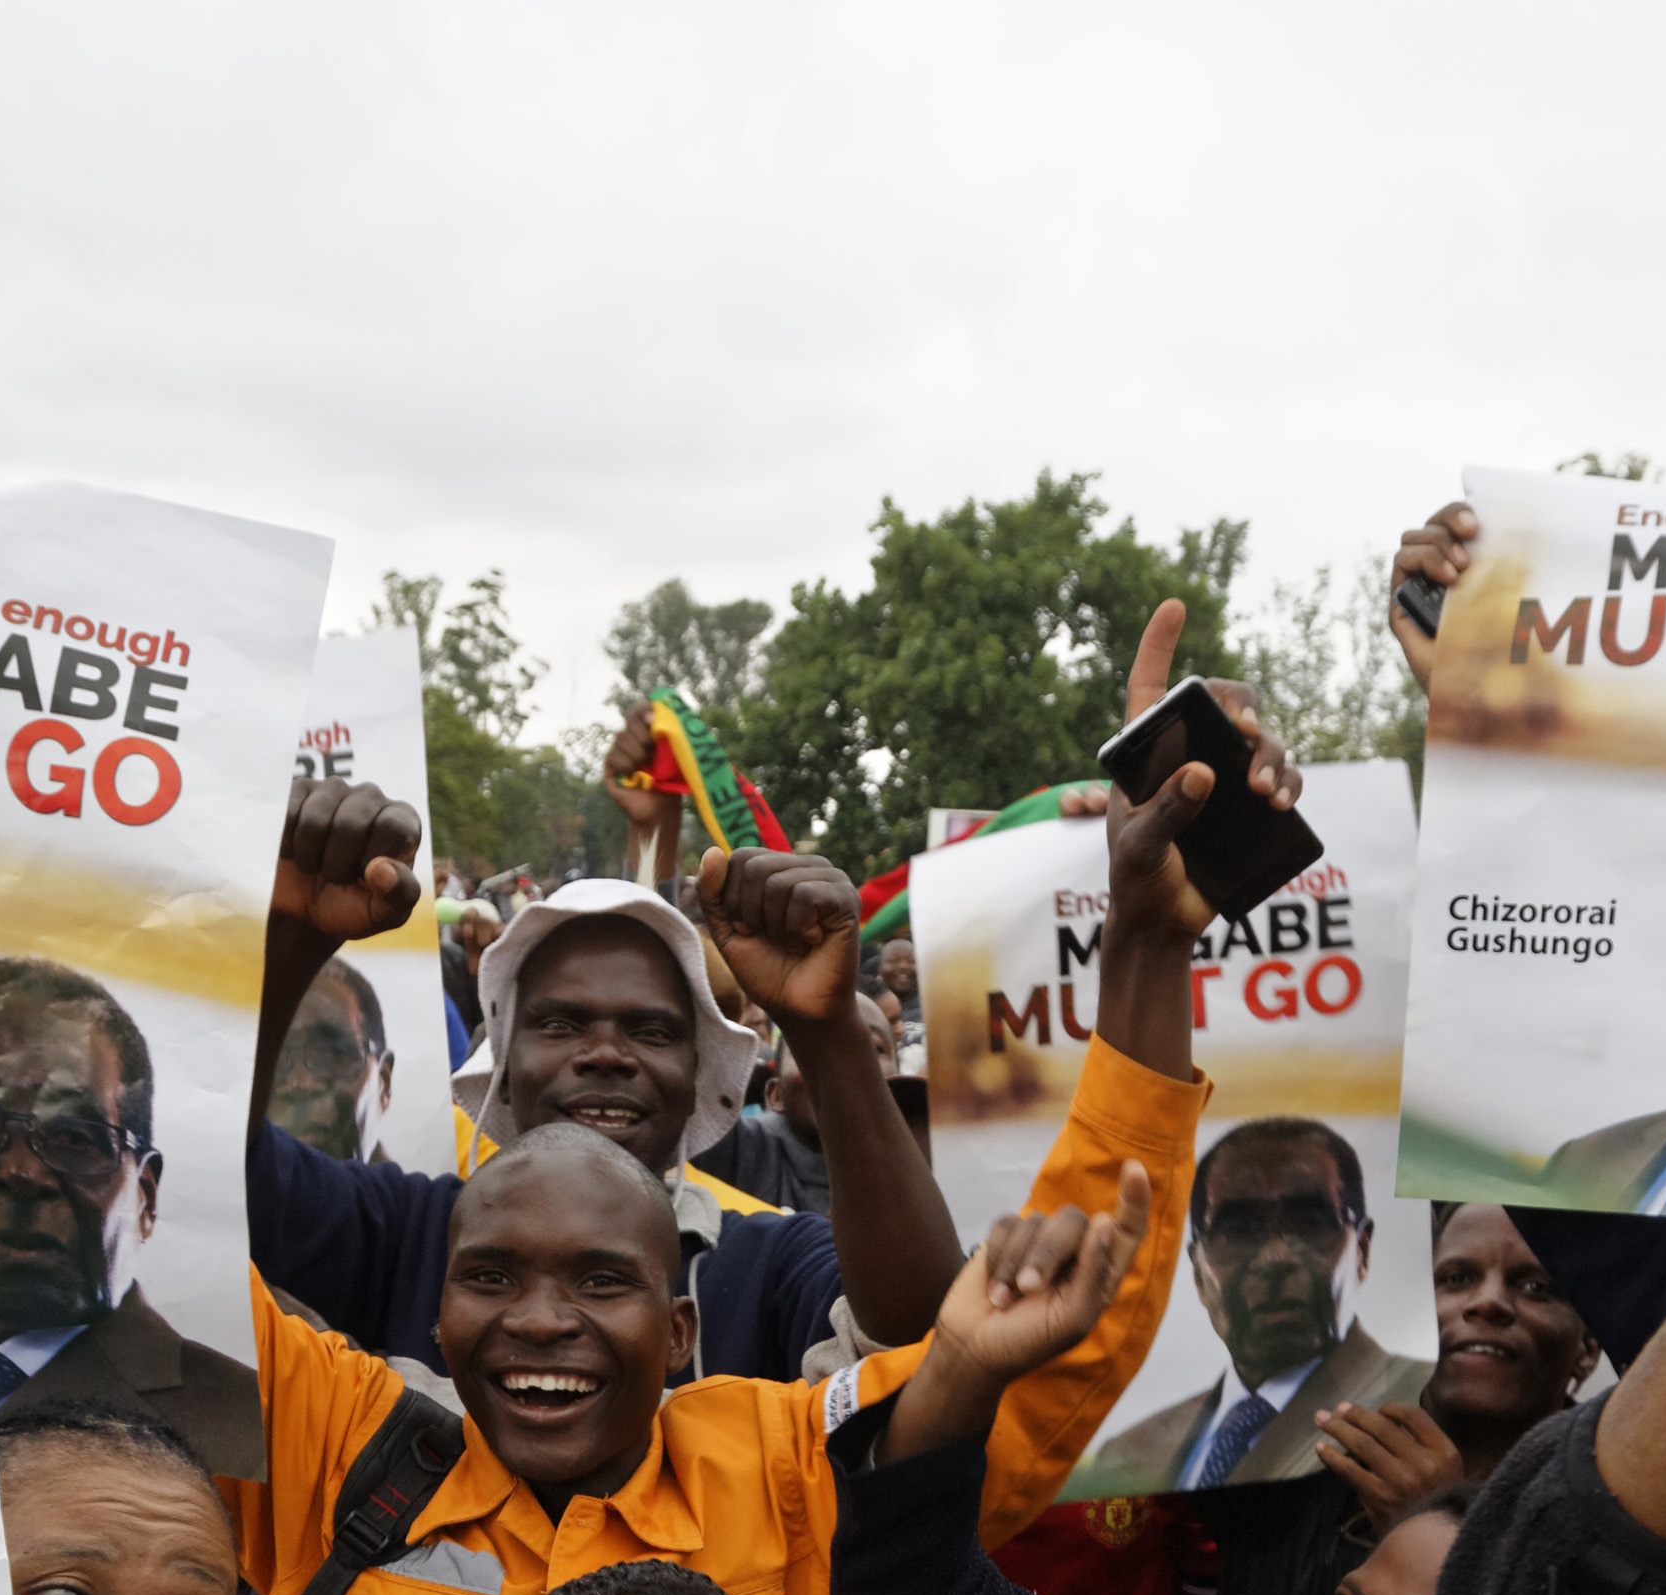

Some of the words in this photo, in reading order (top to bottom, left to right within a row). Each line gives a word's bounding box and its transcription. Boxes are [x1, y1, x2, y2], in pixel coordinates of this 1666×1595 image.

[0, 597, 191, 668] enough
[6, 718, 183, 827] GO
[1054, 889, 1111, 918] Eno
[1057, 896, 1354, 977] MABE
[1448, 894, 1618, 926] Chizororai
[1446, 926, 1615, 963] Gushungo
[988, 966, 1222, 1053] MUT
[1243, 954, 1363, 1023] GO
